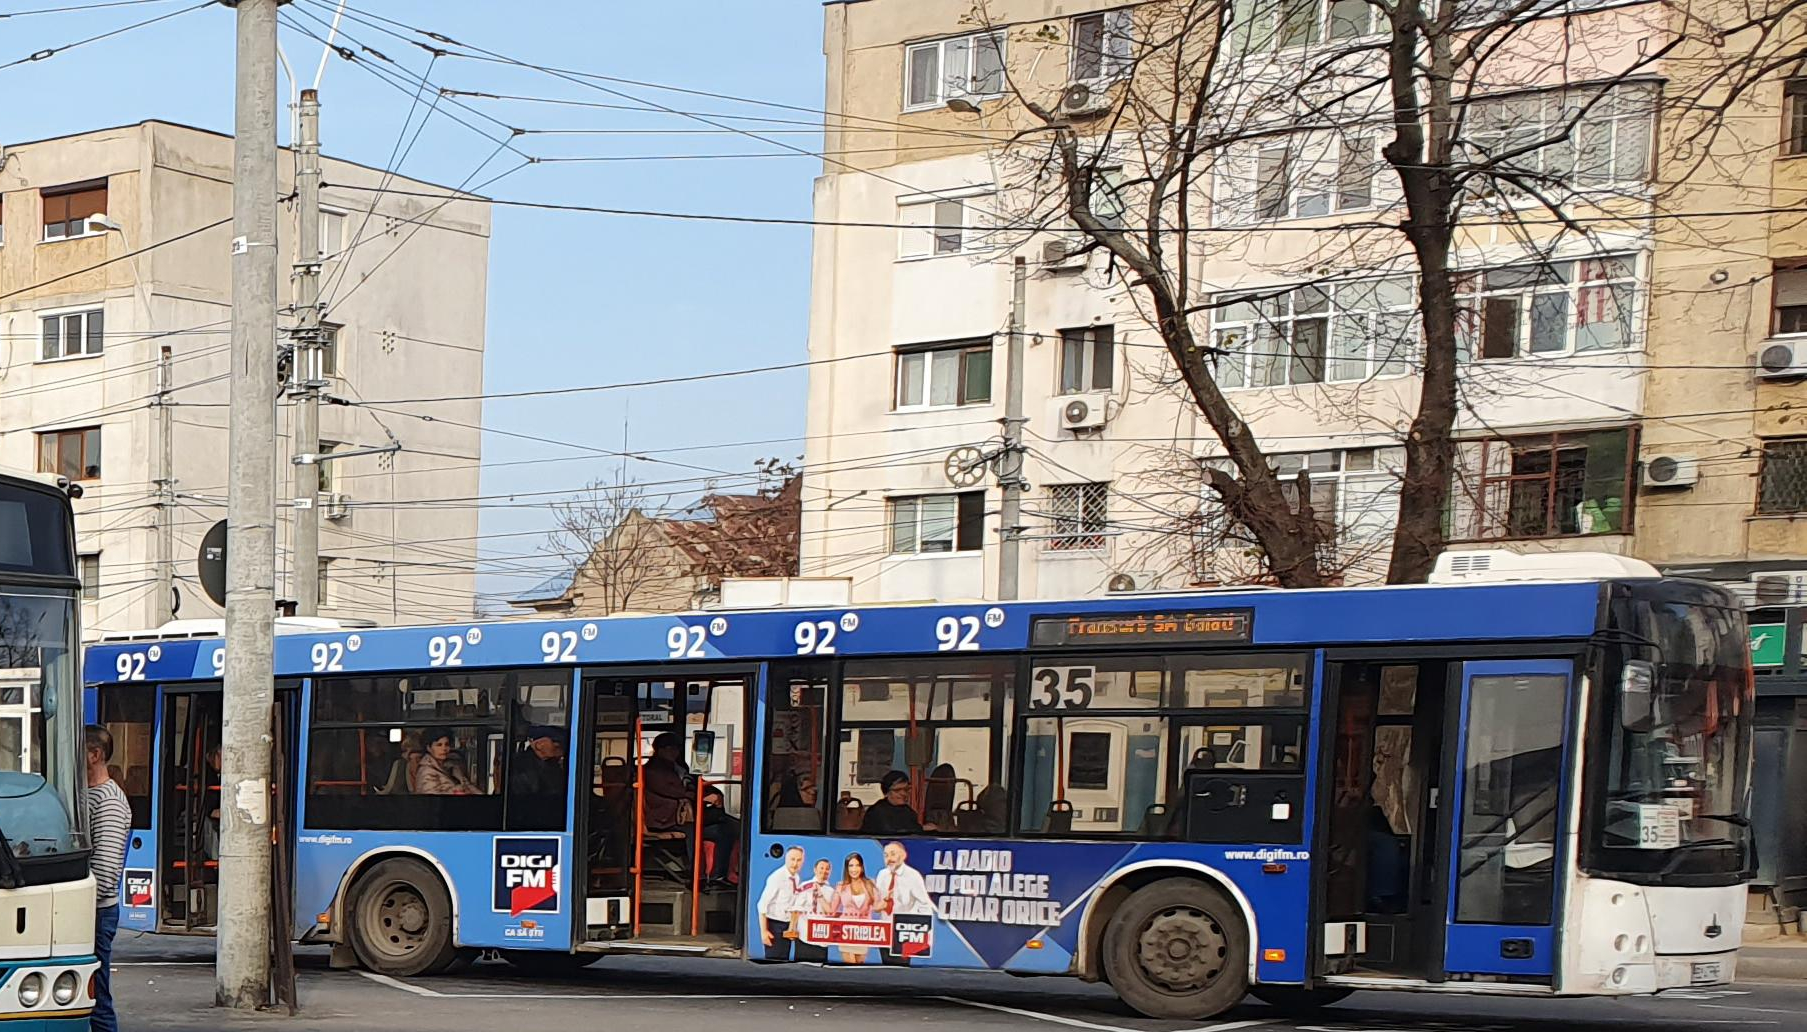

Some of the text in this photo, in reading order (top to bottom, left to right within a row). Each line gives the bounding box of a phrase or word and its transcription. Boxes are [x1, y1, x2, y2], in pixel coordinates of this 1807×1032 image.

[541, 631, 578, 662] 92
[667, 625, 706, 659] 92
[794, 621, 836, 655] 92
[936, 616, 980, 651] 92
[212, 648, 225, 677] 9
[311, 642, 343, 672] 92
[428, 635, 463, 667] 92
[116, 652, 145, 681] 92
[1032, 668, 1092, 711] 35
[501, 854, 552, 868] DIGI
[933, 849, 1012, 872] LA RADIO
[1224, 848, 1309, 862] www.digifm.ro
[506, 870, 546, 888] FM
[989, 872, 1050, 899] ALEGE
[938, 895, 1062, 927] CHIAR ORICE
[895, 922, 929, 932] DIGI
[898, 932, 924, 943] FM
